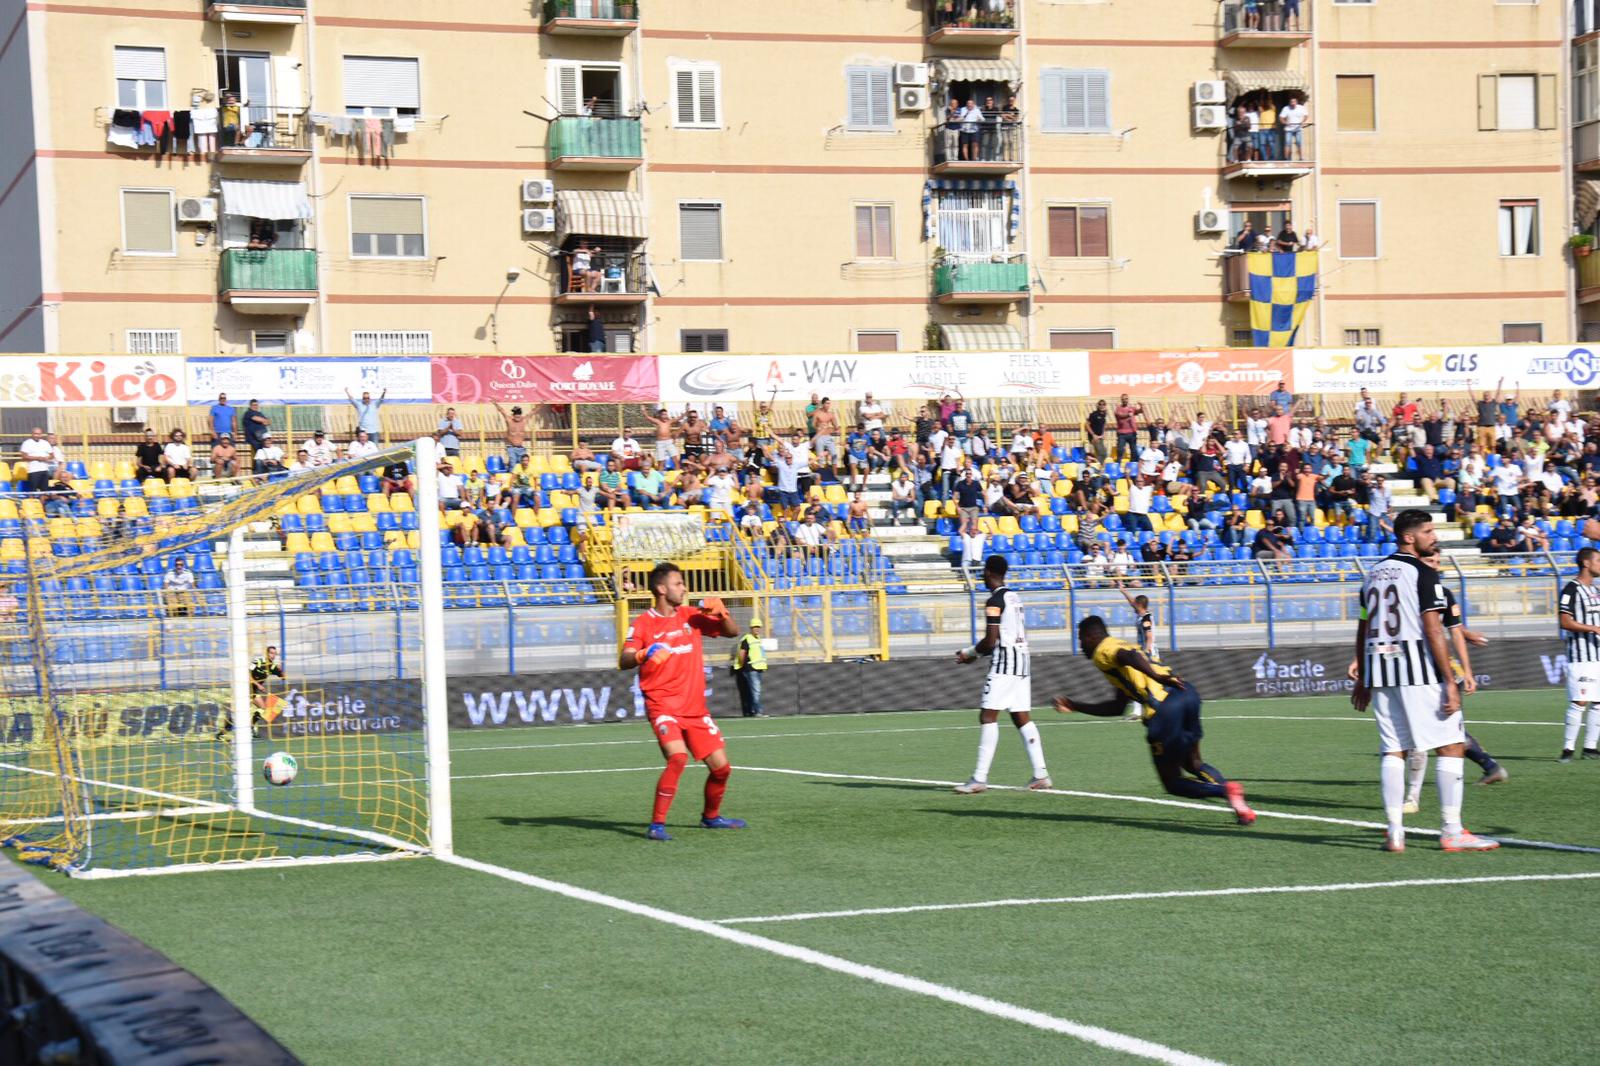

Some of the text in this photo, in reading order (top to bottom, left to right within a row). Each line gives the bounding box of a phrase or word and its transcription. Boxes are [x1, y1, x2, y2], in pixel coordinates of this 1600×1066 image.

[915, 356, 959, 368] FIERA
[1009, 355, 1053, 367] FIERA
[1353, 355, 1386, 373] GLS
[1445, 353, 1478, 372] GLS
[37, 361, 177, 401] Kico
[908, 372, 968, 386] MOBILE
[1003, 371, 1061, 384] MOBILE
[1099, 371, 1174, 387] expert
[1367, 583, 1401, 638] 23
